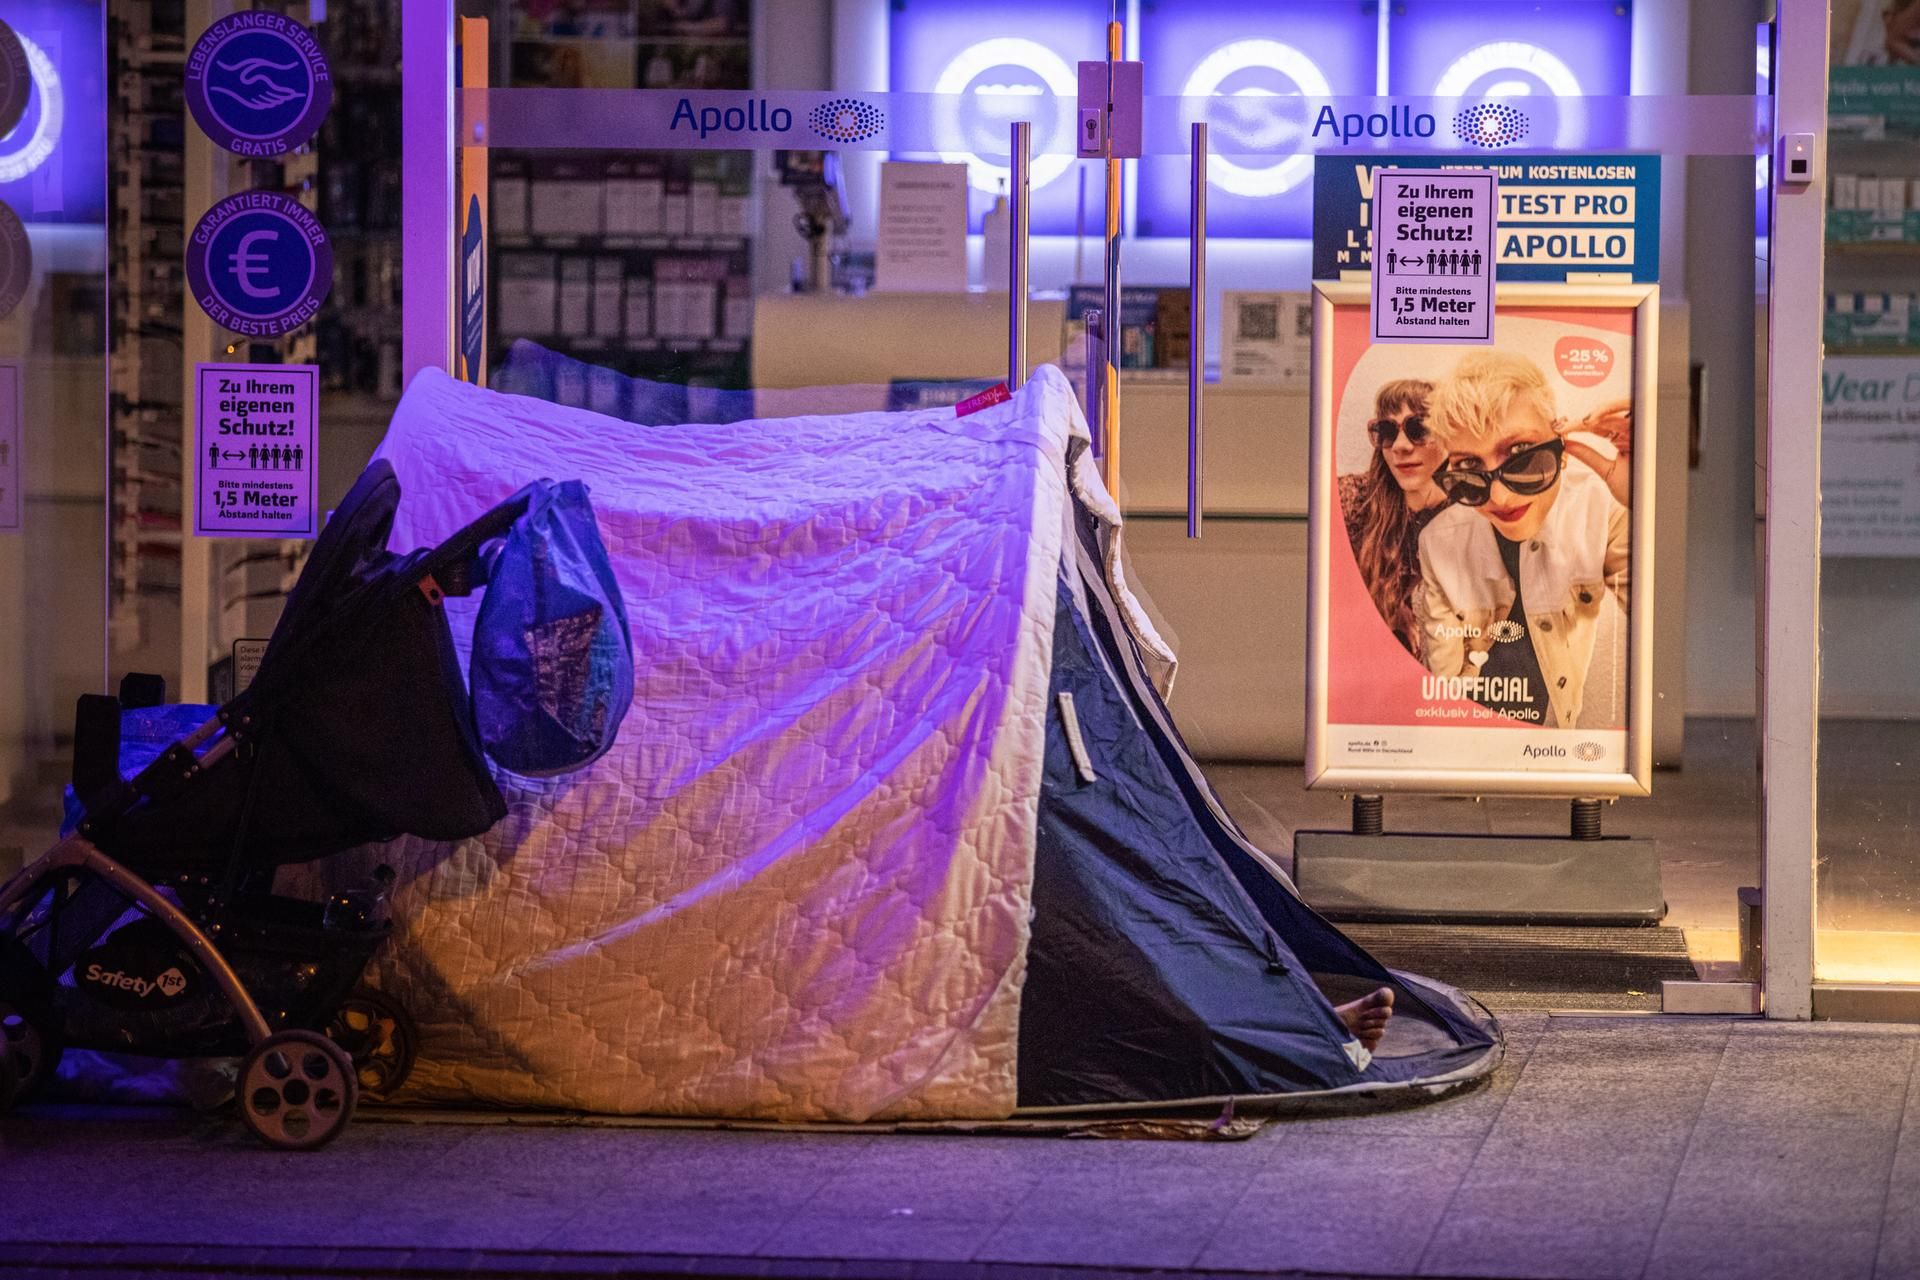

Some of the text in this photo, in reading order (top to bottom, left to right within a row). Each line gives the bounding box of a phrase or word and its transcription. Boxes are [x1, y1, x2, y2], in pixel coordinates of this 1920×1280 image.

[188, 14, 328, 82] LEBENSLANGER SERVICE
[669, 98, 792, 139] Apollo
[1311, 105, 1436, 146] Apollo
[231, 138, 287, 155] GRATIS
[1529, 166, 1636, 179] KOSTENLOSEN
[1397, 184, 1473, 199] Zu Ihrem
[1397, 201, 1473, 222] eigenen
[1574, 194, 1628, 215] PRO
[194, 194, 326, 246] GARANTIERT IMMER
[1396, 224, 1473, 242] Schutz!
[1502, 234, 1627, 258] APOLLO
[1395, 286, 1472, 296] Bitte mindestens
[201, 295, 319, 335] DER BESTE PREIS
[1390, 297, 1476, 315] 1,5 Meter
[1395, 316, 1470, 326] Abstand halten
[218, 379, 295, 394] Zu Ihrem
[219, 396, 295, 417] eigenen
[218, 418, 295, 436] Schutz!
[218, 480, 294, 490] Bitte mindestens
[213, 491, 298, 509] 1,5 Meter
[218, 510, 292, 520] Abstand halten
[1434, 623, 1482, 640] Apollo
[1421, 675, 1534, 702] UNOFFICIAL
[1415, 706, 1540, 721] exklusiv bei Apollo
[1522, 744, 1567, 760] Apollo
[85, 964, 183, 998] Safety 1st
